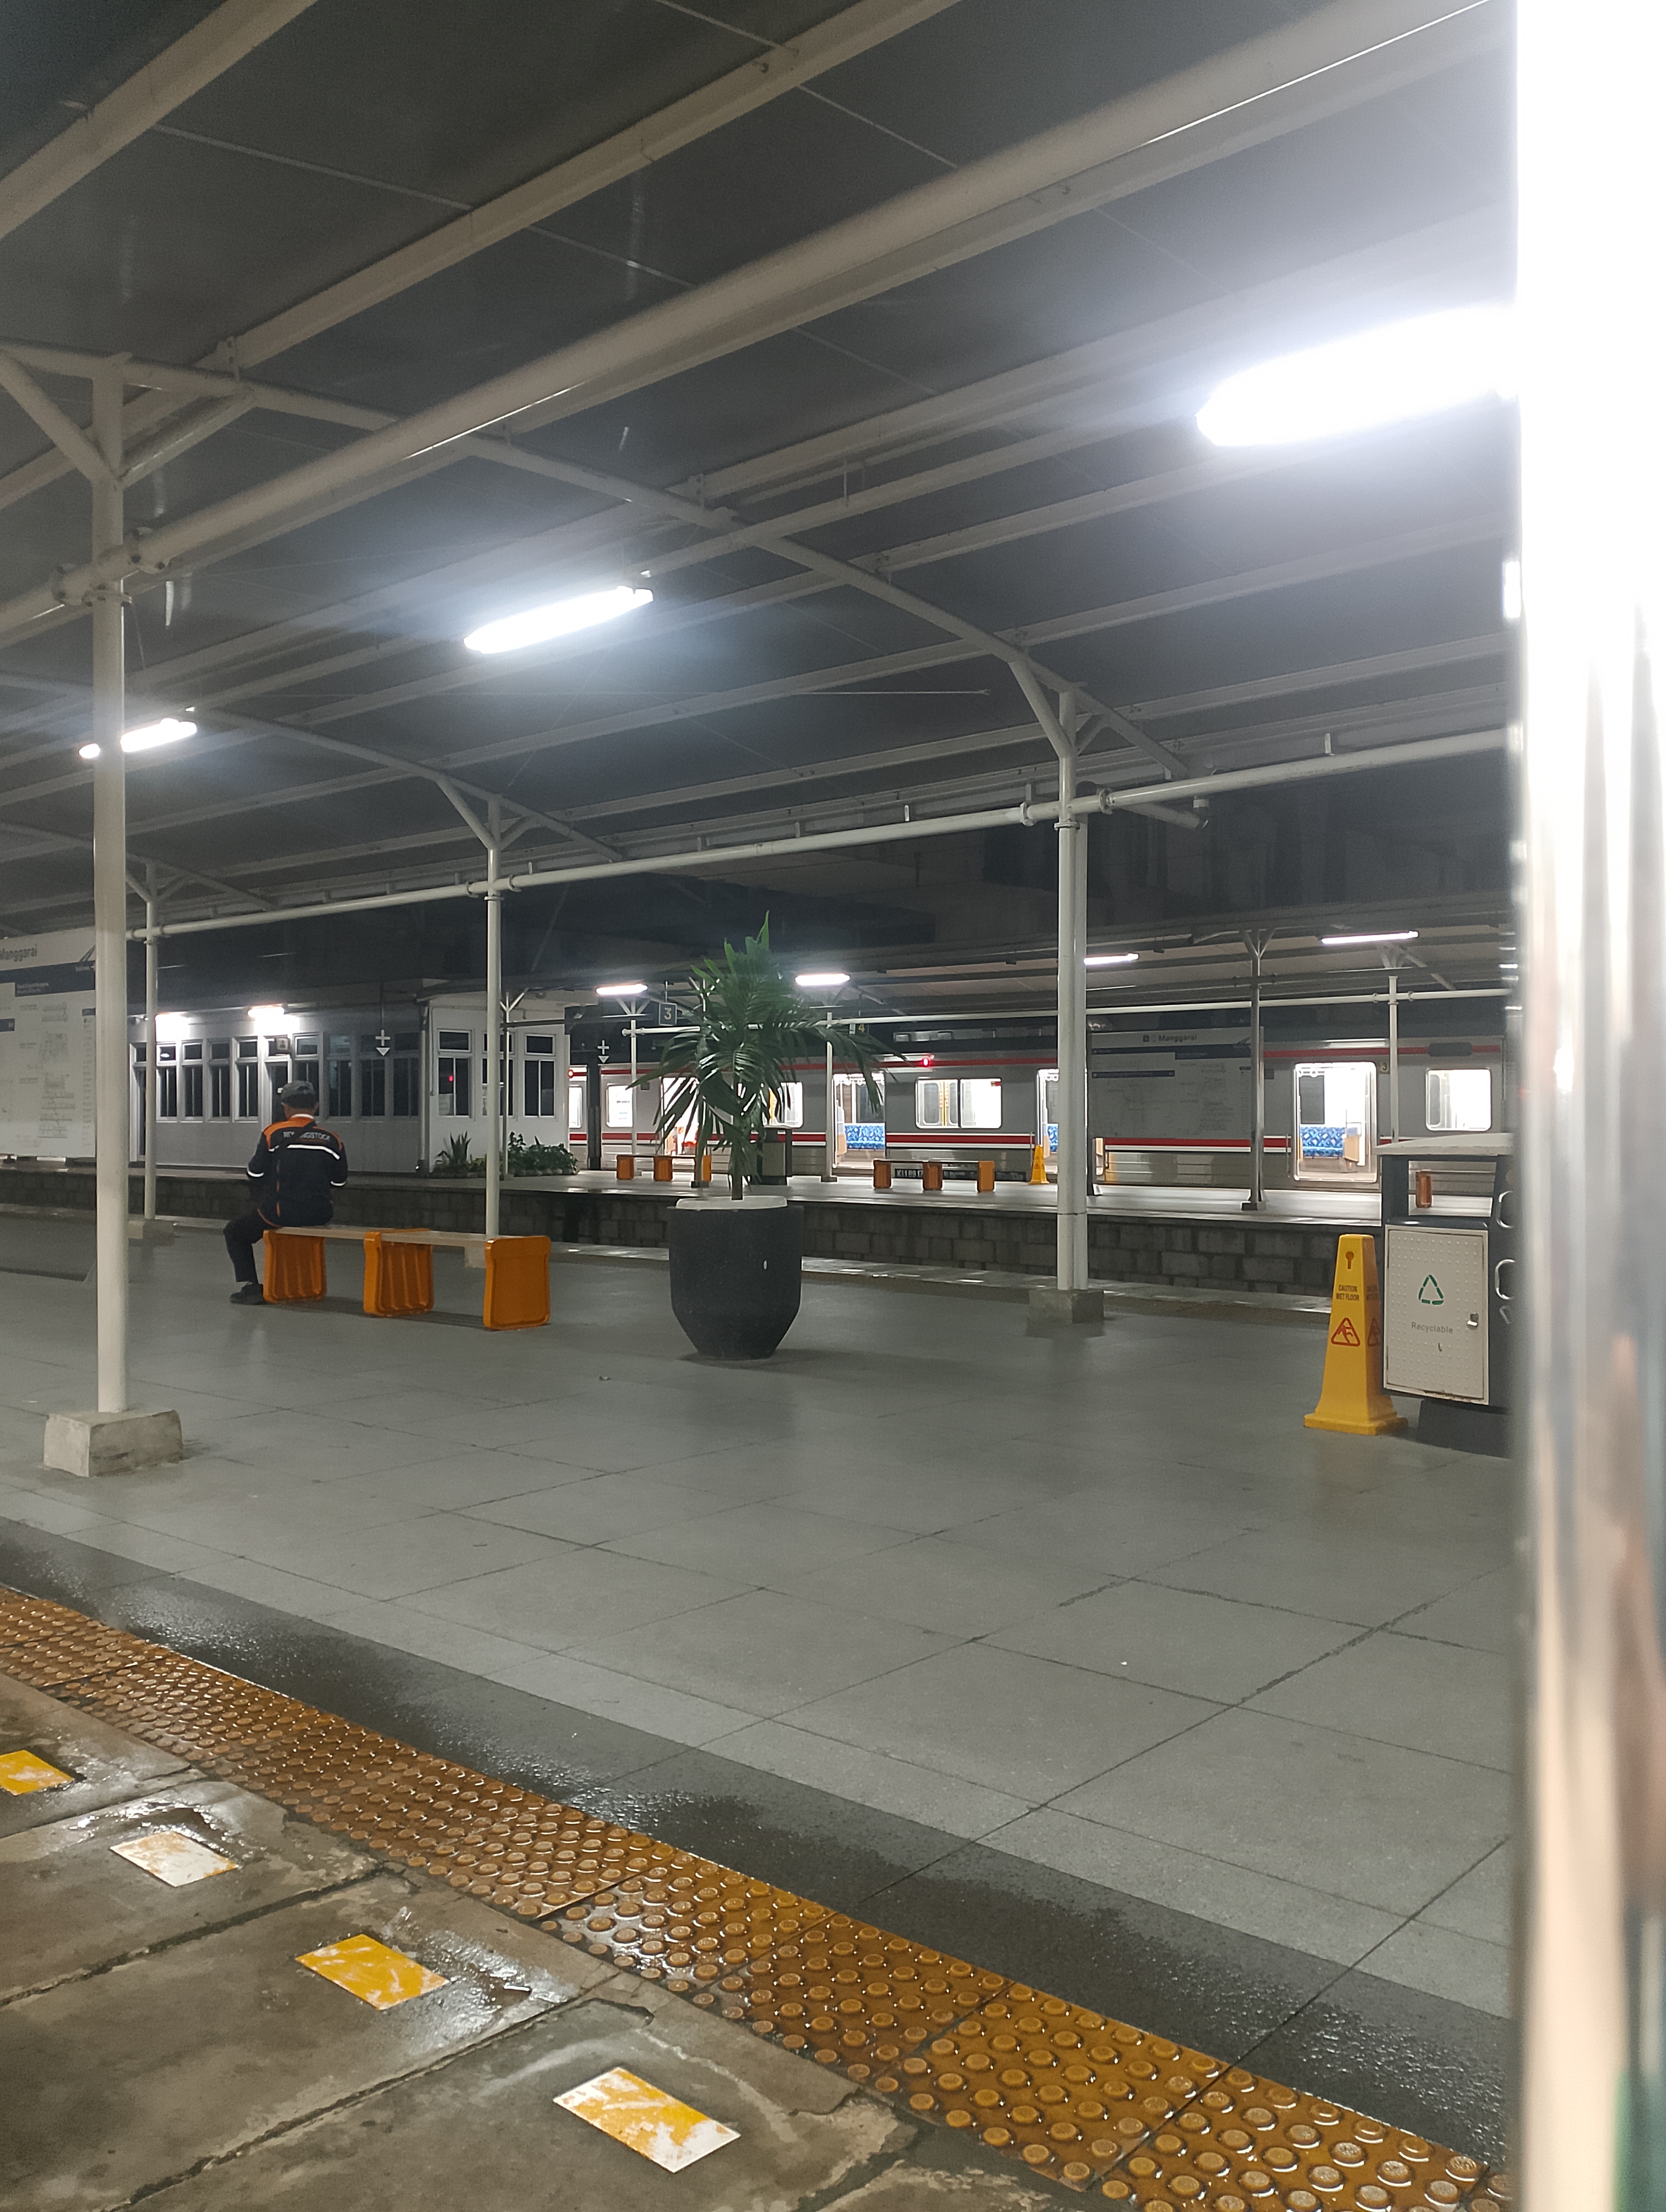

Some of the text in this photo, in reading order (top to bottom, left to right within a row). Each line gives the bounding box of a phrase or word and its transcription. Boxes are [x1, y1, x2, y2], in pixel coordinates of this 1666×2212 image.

[0, 944, 37, 962] Manggarai
[664, 1007, 672, 1020] 3
[858, 1023, 865, 1033] 4
[1158, 1033, 1197, 1043] Manggarai
[1338, 1284, 1357, 1293] CAUTION
[1411, 1321, 1453, 1334] Recyclable
